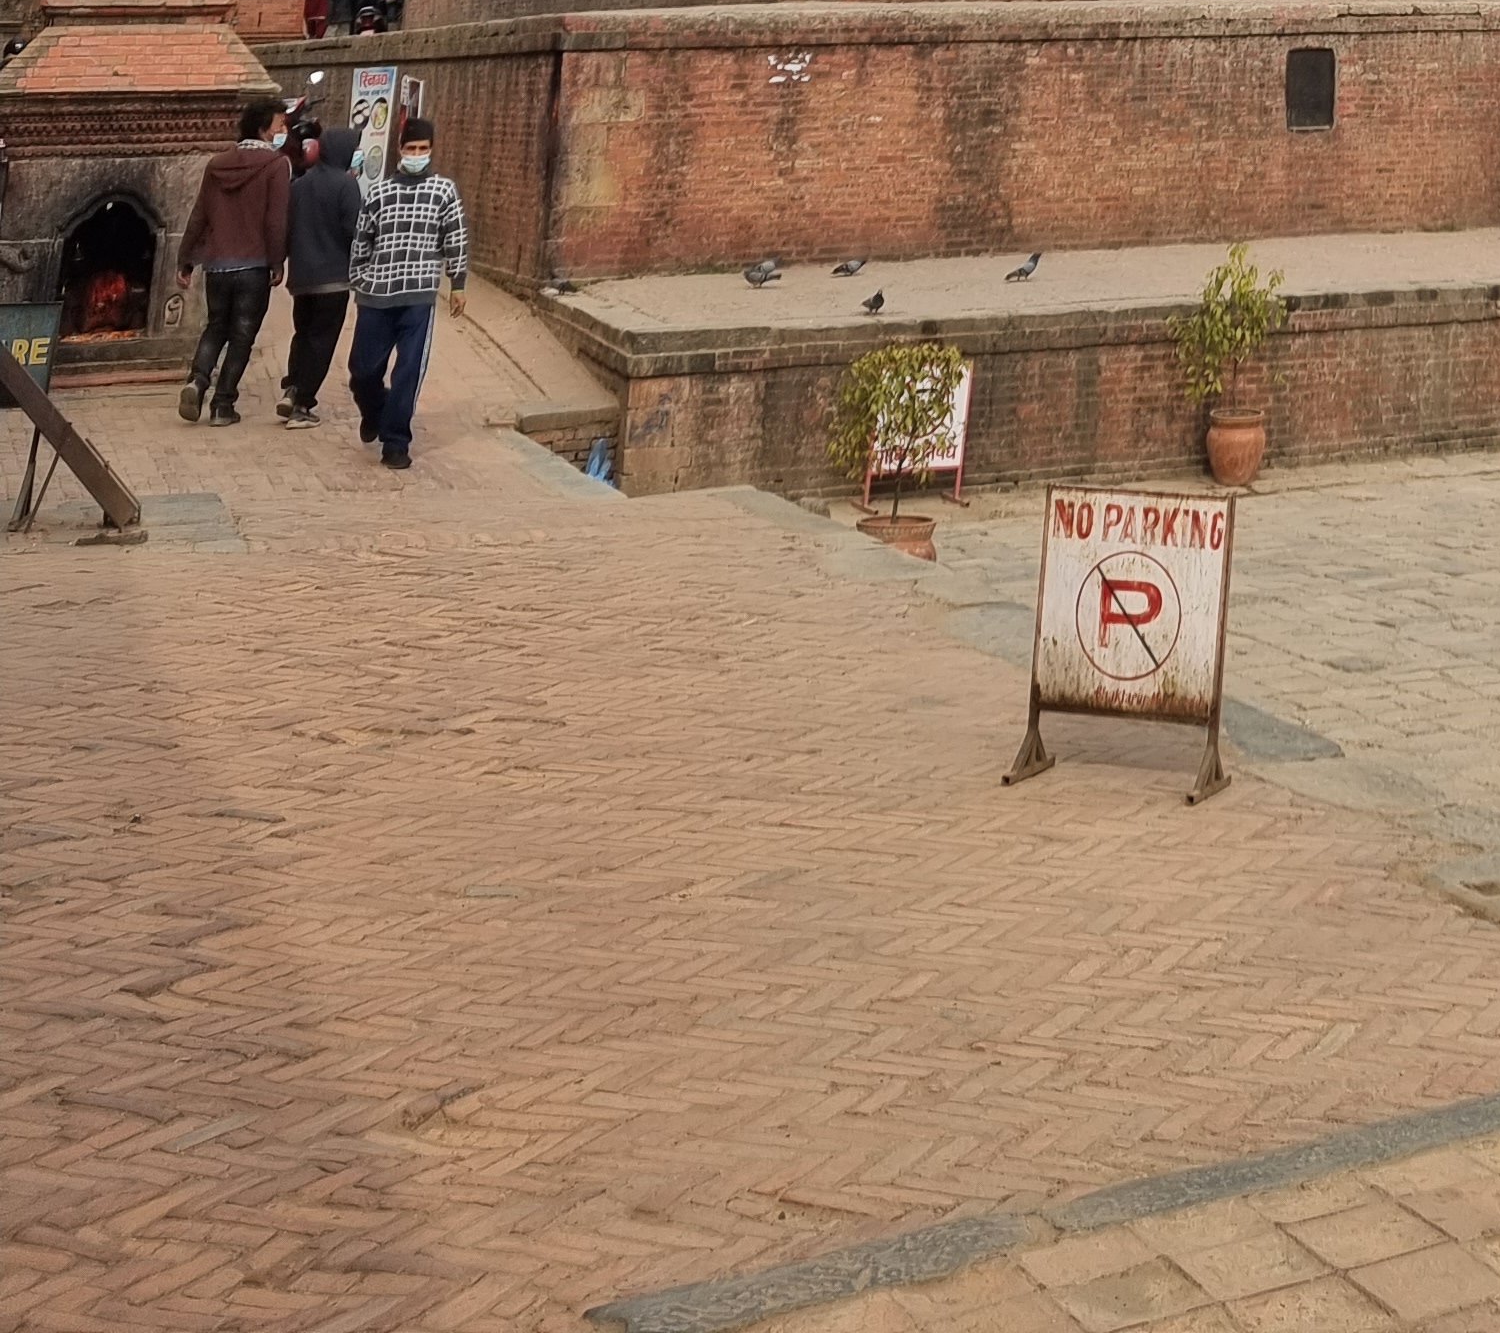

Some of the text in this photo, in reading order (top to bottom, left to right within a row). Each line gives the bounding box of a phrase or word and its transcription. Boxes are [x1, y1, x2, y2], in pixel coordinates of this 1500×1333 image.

[2, 337, 51, 365] RE
[1053, 498, 1225, 551] NO PARKING
[1099, 579, 1163, 648] P
